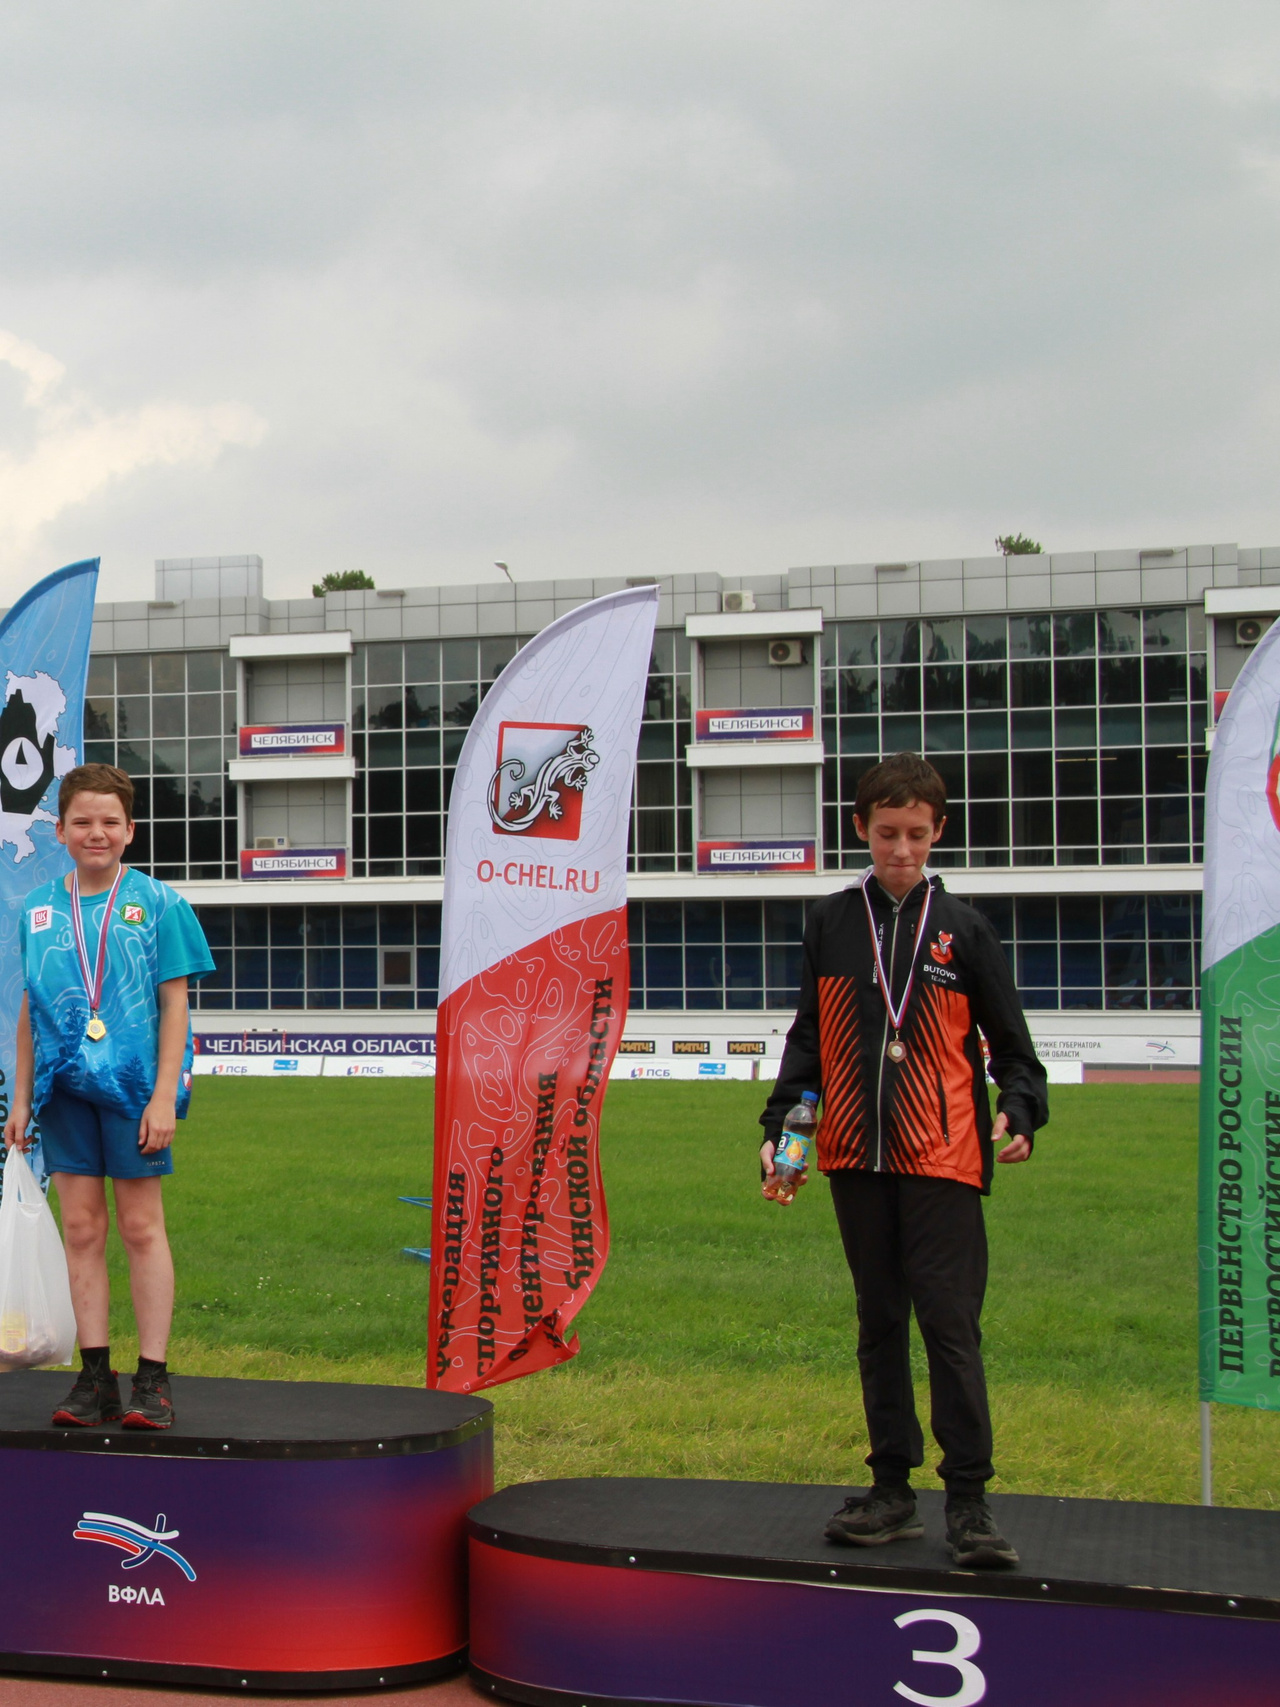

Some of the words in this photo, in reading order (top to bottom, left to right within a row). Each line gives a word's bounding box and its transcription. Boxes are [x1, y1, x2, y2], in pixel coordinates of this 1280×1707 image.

[711, 718, 800, 730] ЧЕЛЯБИНСК
[254, 734, 333, 746] ЧЕЛЯБИНСК
[254, 858, 334, 870] ЧЕЛЯБИНСК
[713, 851, 802, 862] ЧЕЛЯБИНСК
[477, 859, 600, 894] O-CHEL.RU
[923, 964, 956, 981] BUTOVO
[206, 1039, 347, 1053] ЧЕЛЯБИНСКАЯ
[574, 976, 614, 1127] области
[1059, 1041, 1101, 1049] ГУБЕРНАТОРА
[1052, 1050, 1080, 1058] ОБЛАСТИ
[646, 1068, 671, 1077] ПСБ
[1218, 1015, 1242, 1153] РОССИИ
[477, 1146, 504, 1377] спортивного
[1218, 1158, 1244, 1374] ПЕРВЕНСТВО
[108, 1584, 166, 1606] ВФЛА
[892, 1608, 986, 1707] 3
